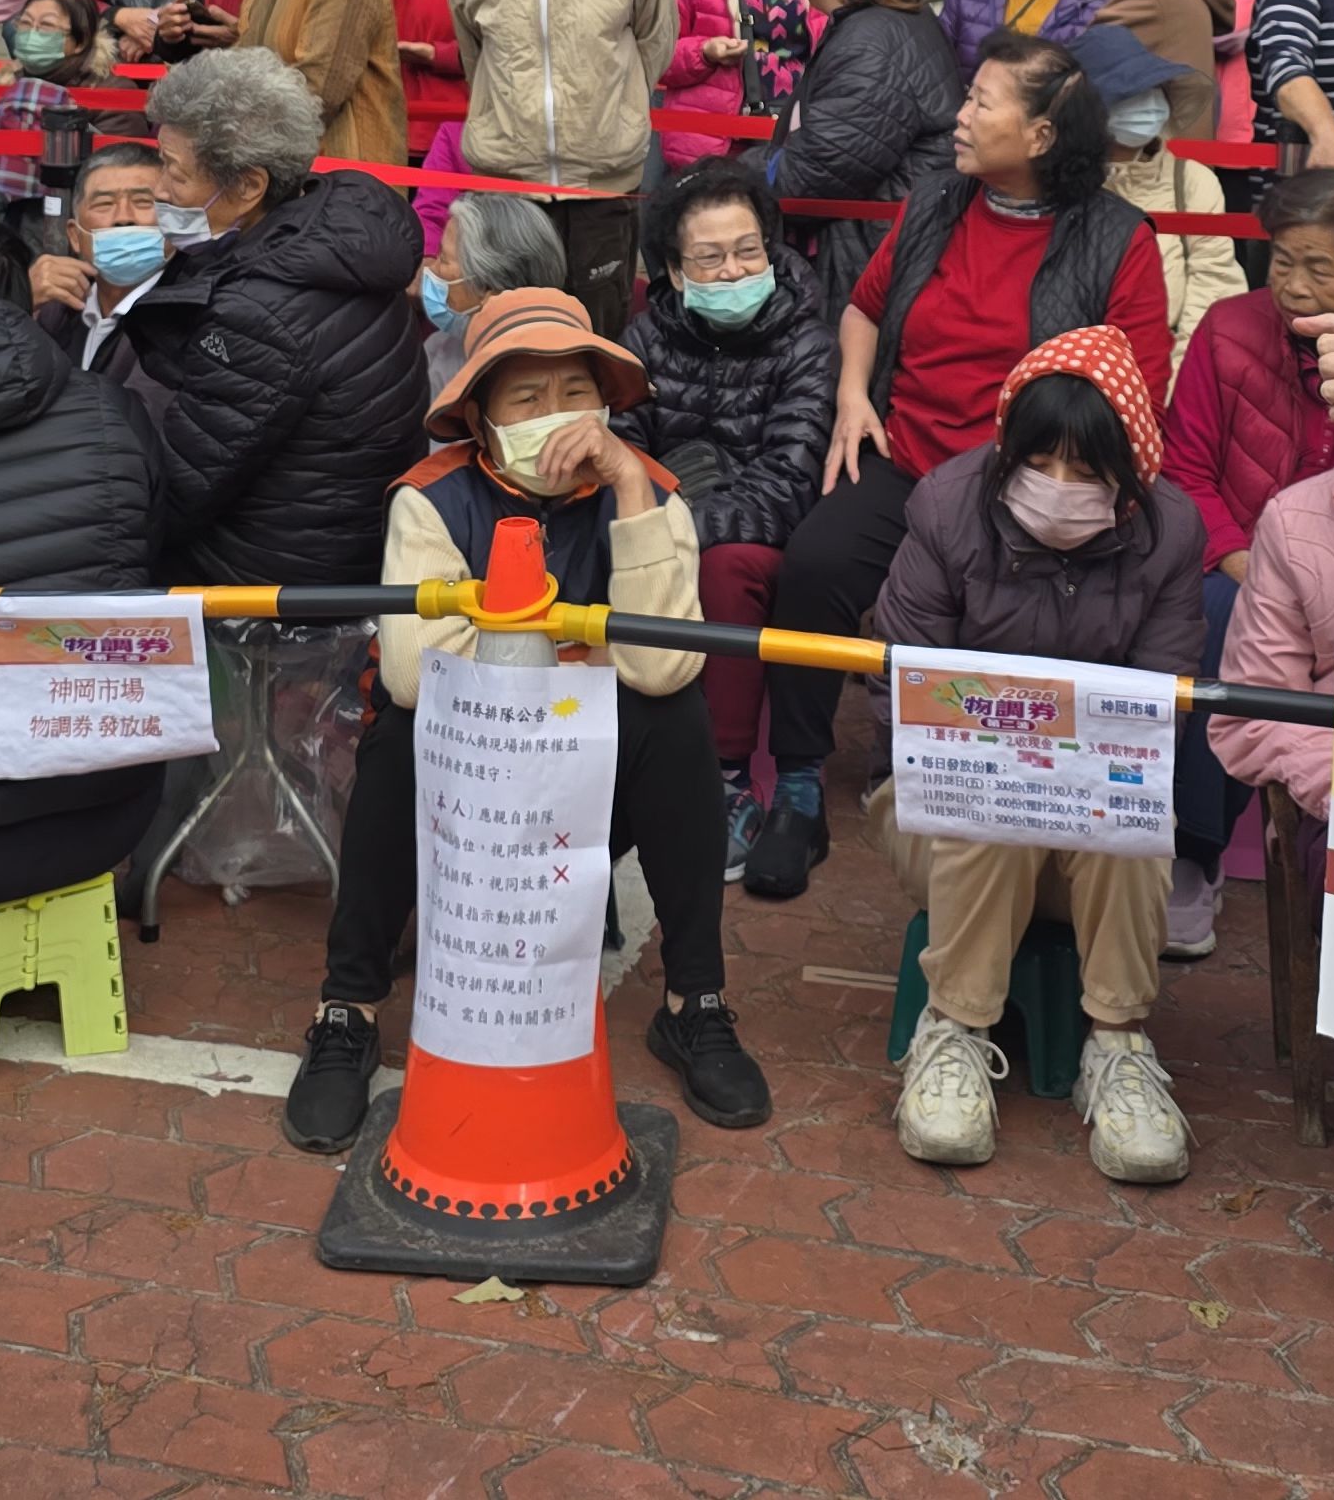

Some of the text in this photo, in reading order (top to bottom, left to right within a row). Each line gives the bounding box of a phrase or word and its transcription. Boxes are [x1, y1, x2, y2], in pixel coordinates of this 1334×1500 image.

[64, 638, 171, 654] 物調券
[49, 677, 145, 703] 神岡市場
[963, 696, 1058, 721] 物調券
[1100, 699, 1159, 719] 神岡市場
[30, 715, 162, 738] 物調券 發放處
